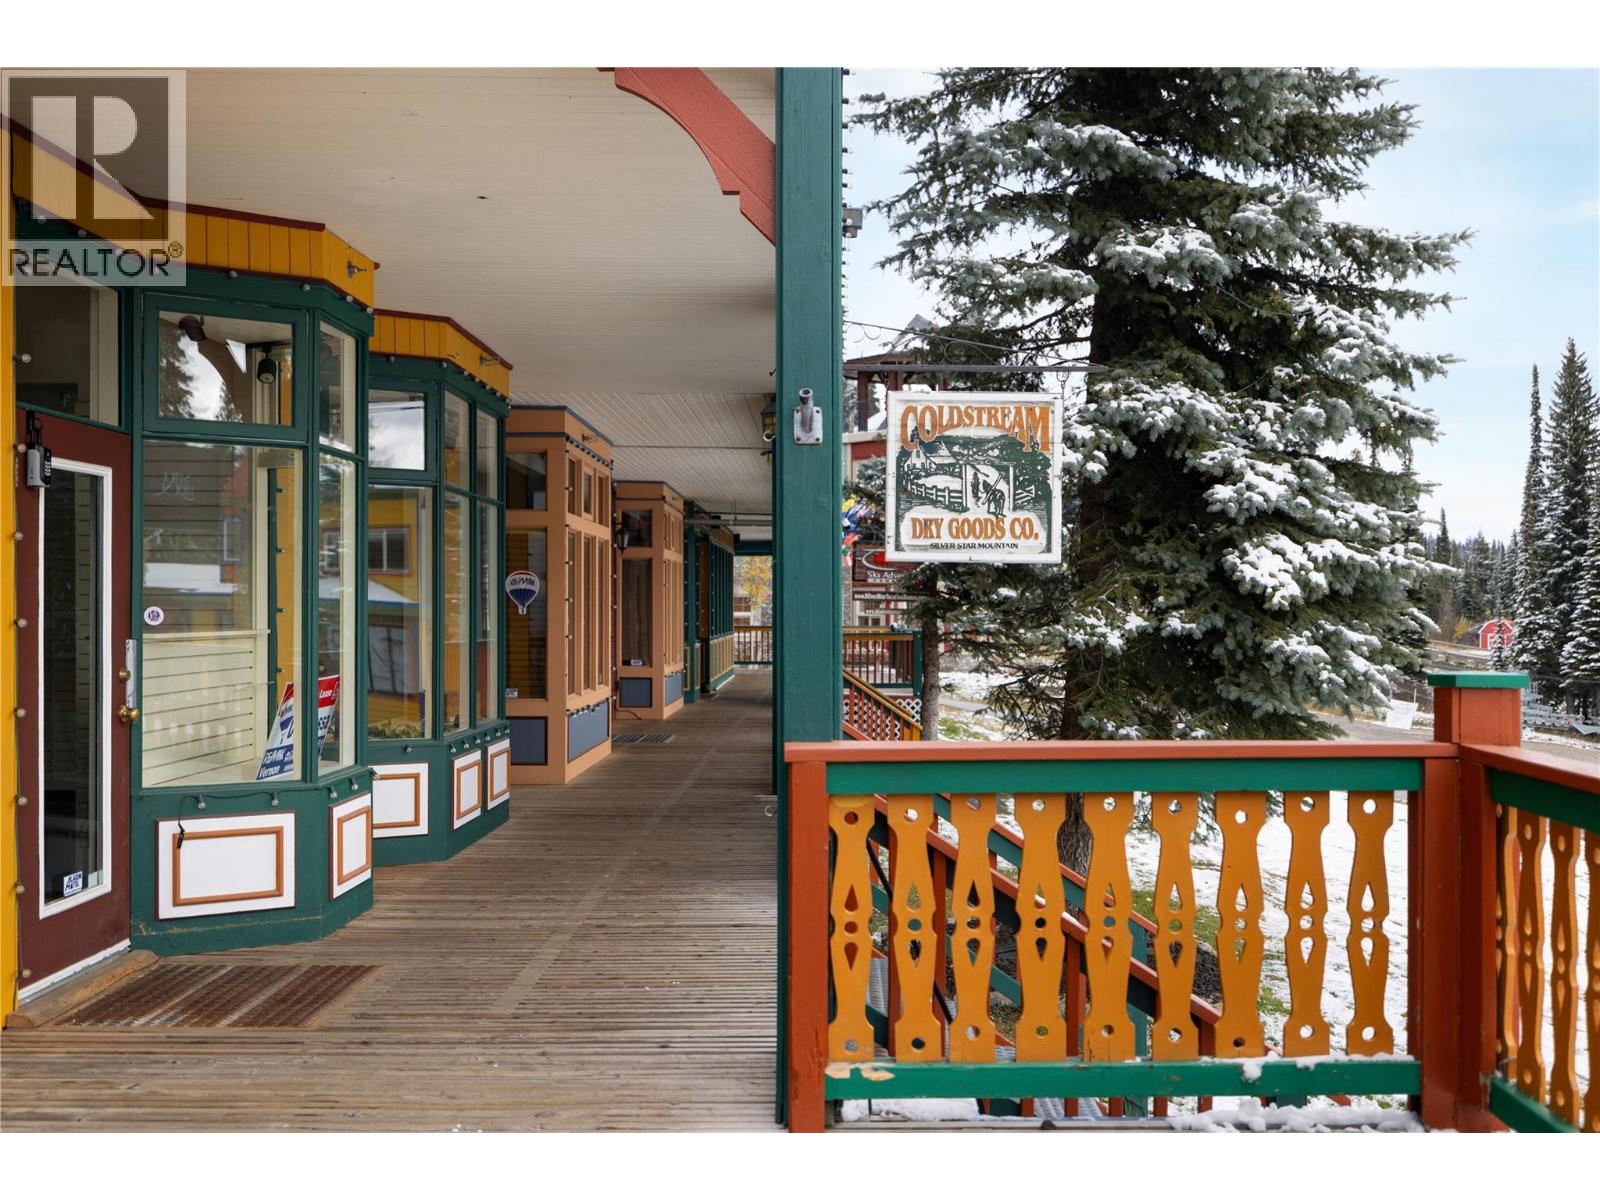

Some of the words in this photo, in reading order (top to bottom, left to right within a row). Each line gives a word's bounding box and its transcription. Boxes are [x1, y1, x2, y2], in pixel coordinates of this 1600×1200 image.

[901, 404, 1052, 452] COLDSTREAM
[911, 517, 944, 540] DRY
[947, 517, 1006, 540] GOODS
[1010, 517, 1040, 540] CO.
[930, 542, 956, 550] SILVER
[956, 542, 977, 550] STAR
[259, 764, 280, 779] Vernon
